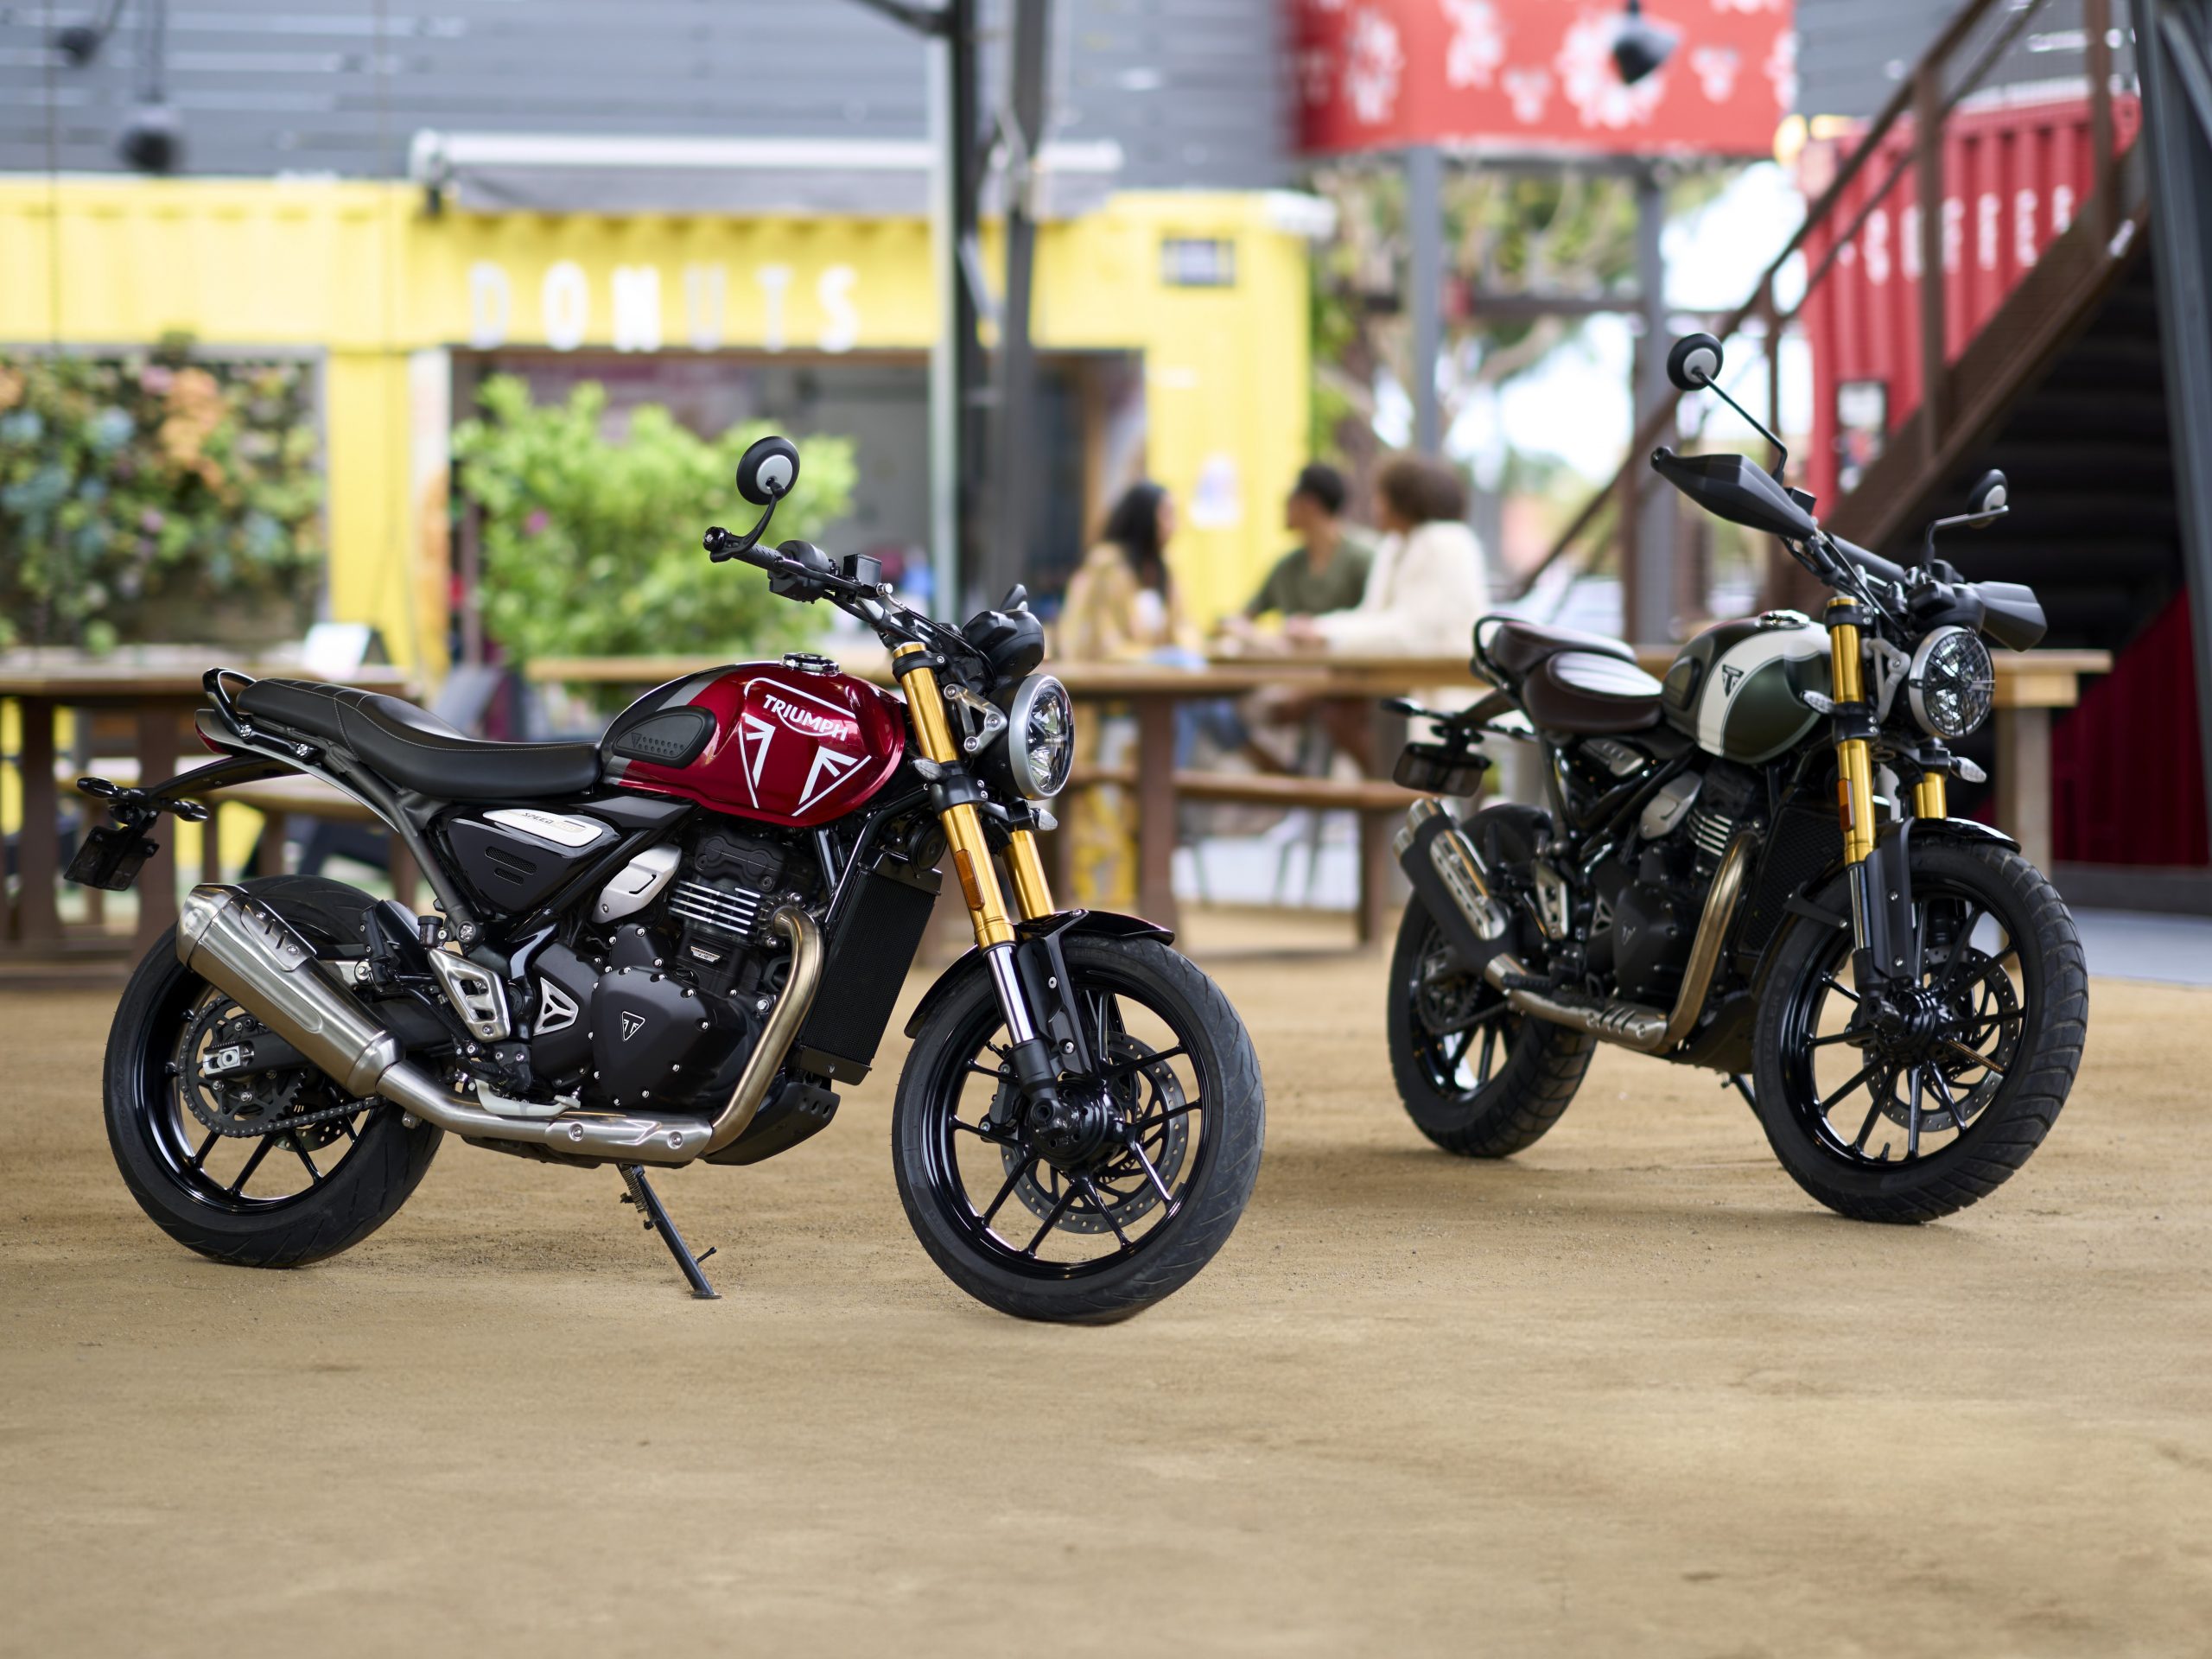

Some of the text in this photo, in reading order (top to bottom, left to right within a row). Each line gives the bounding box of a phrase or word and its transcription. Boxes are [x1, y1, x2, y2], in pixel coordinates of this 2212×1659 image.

[468, 260, 861, 353] DONUTS
[763, 694, 849, 741] TRIUMPH
[521, 812, 555, 824] SPEED
